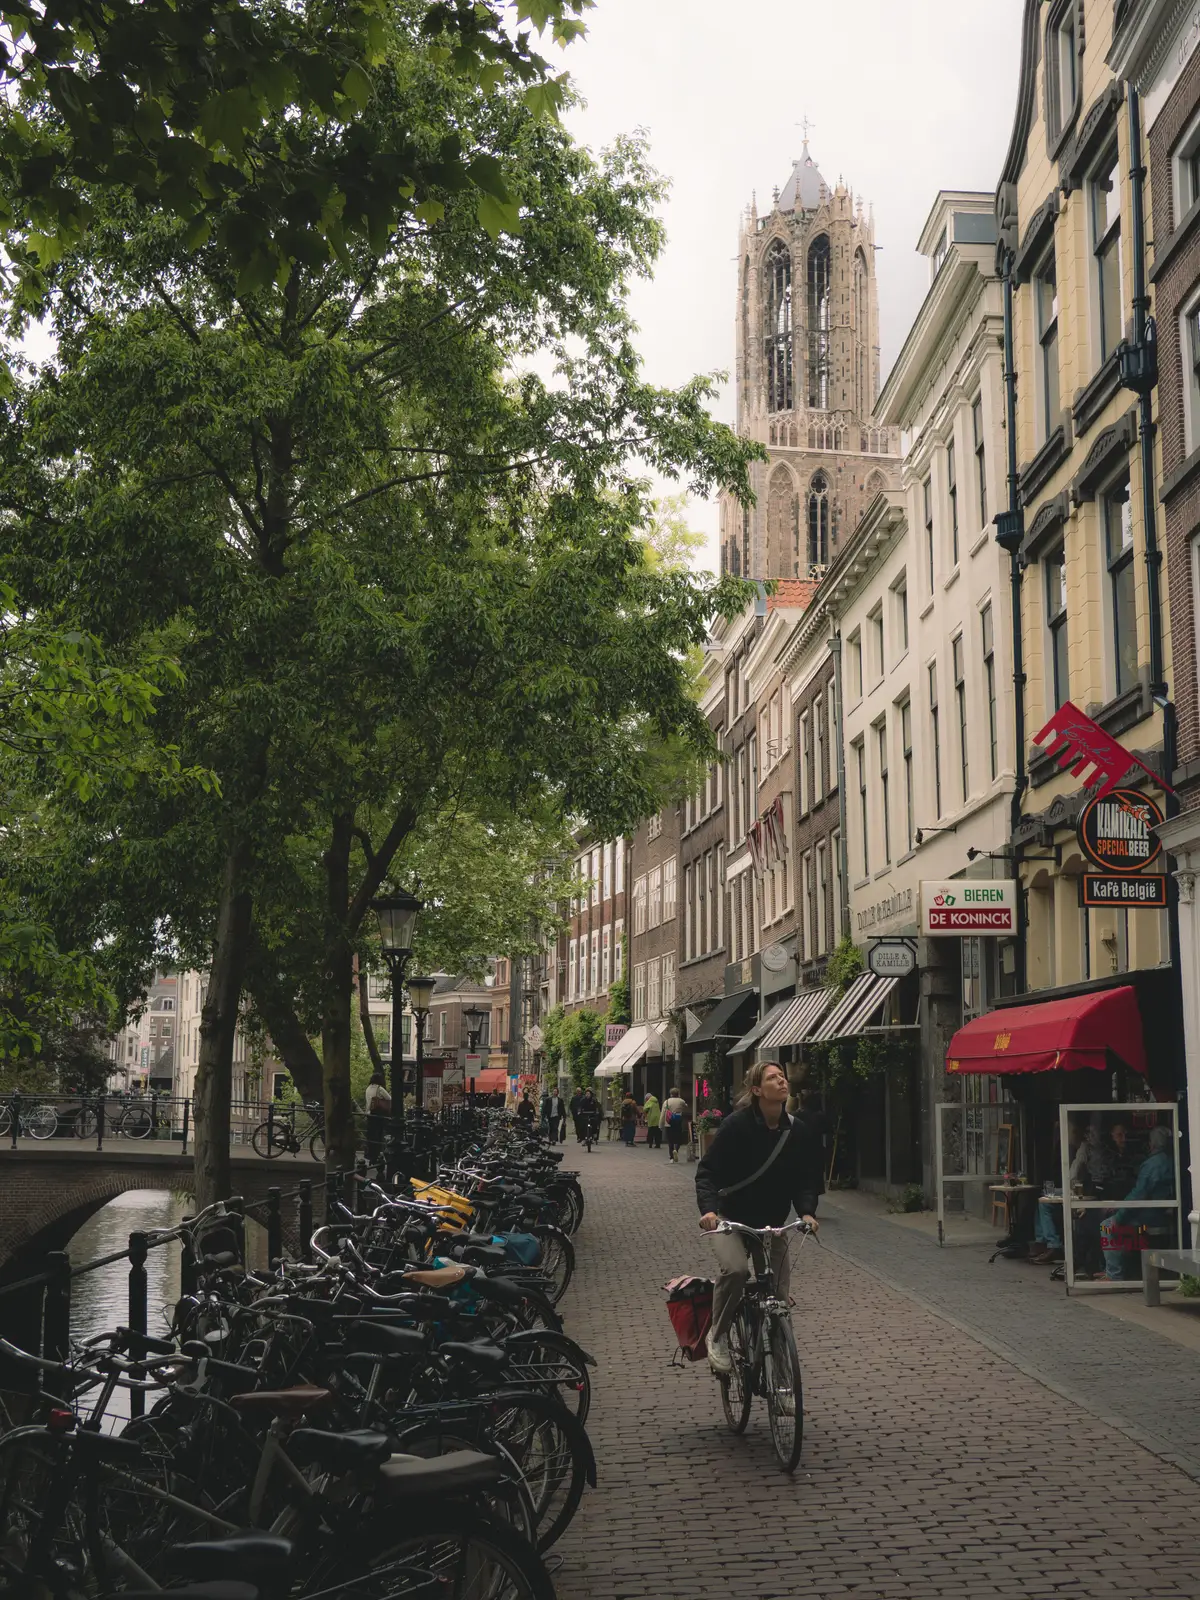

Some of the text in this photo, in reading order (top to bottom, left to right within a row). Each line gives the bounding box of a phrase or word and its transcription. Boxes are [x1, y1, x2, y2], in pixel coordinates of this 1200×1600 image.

[1096, 803, 1150, 839] KAMIKAZE
[964, 889, 1004, 902] BIEREN
[1093, 881, 1156, 901] Kafé België
[930, 912, 1011, 925] DE KONINCK
[878, 952, 908, 960] DILLE &
